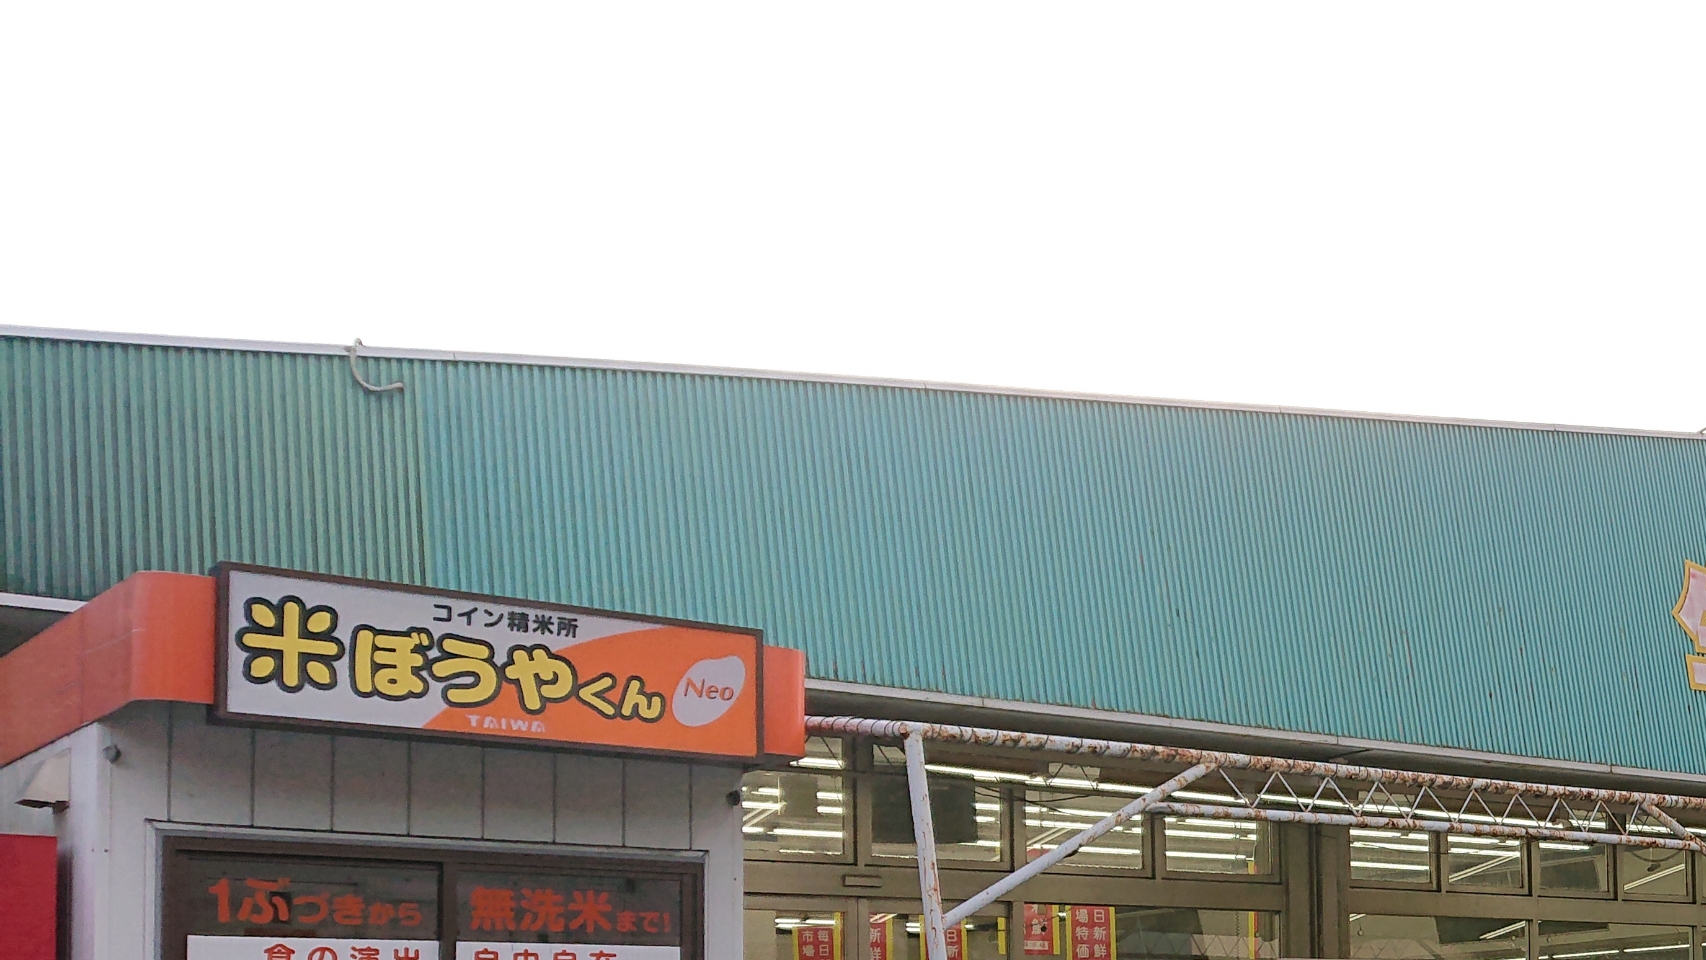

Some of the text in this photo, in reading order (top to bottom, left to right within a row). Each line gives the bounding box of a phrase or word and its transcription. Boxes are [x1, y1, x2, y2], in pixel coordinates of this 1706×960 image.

[432, 603, 579, 639] コイン精米所
[237, 595, 666, 724] 米ぼうやくん
[683, 677, 735, 702] Neo
[465, 714, 546, 733] TAIWA
[208, 877, 422, 926] 1ぶづきから
[469, 885, 672, 933] 無洗米まで!
